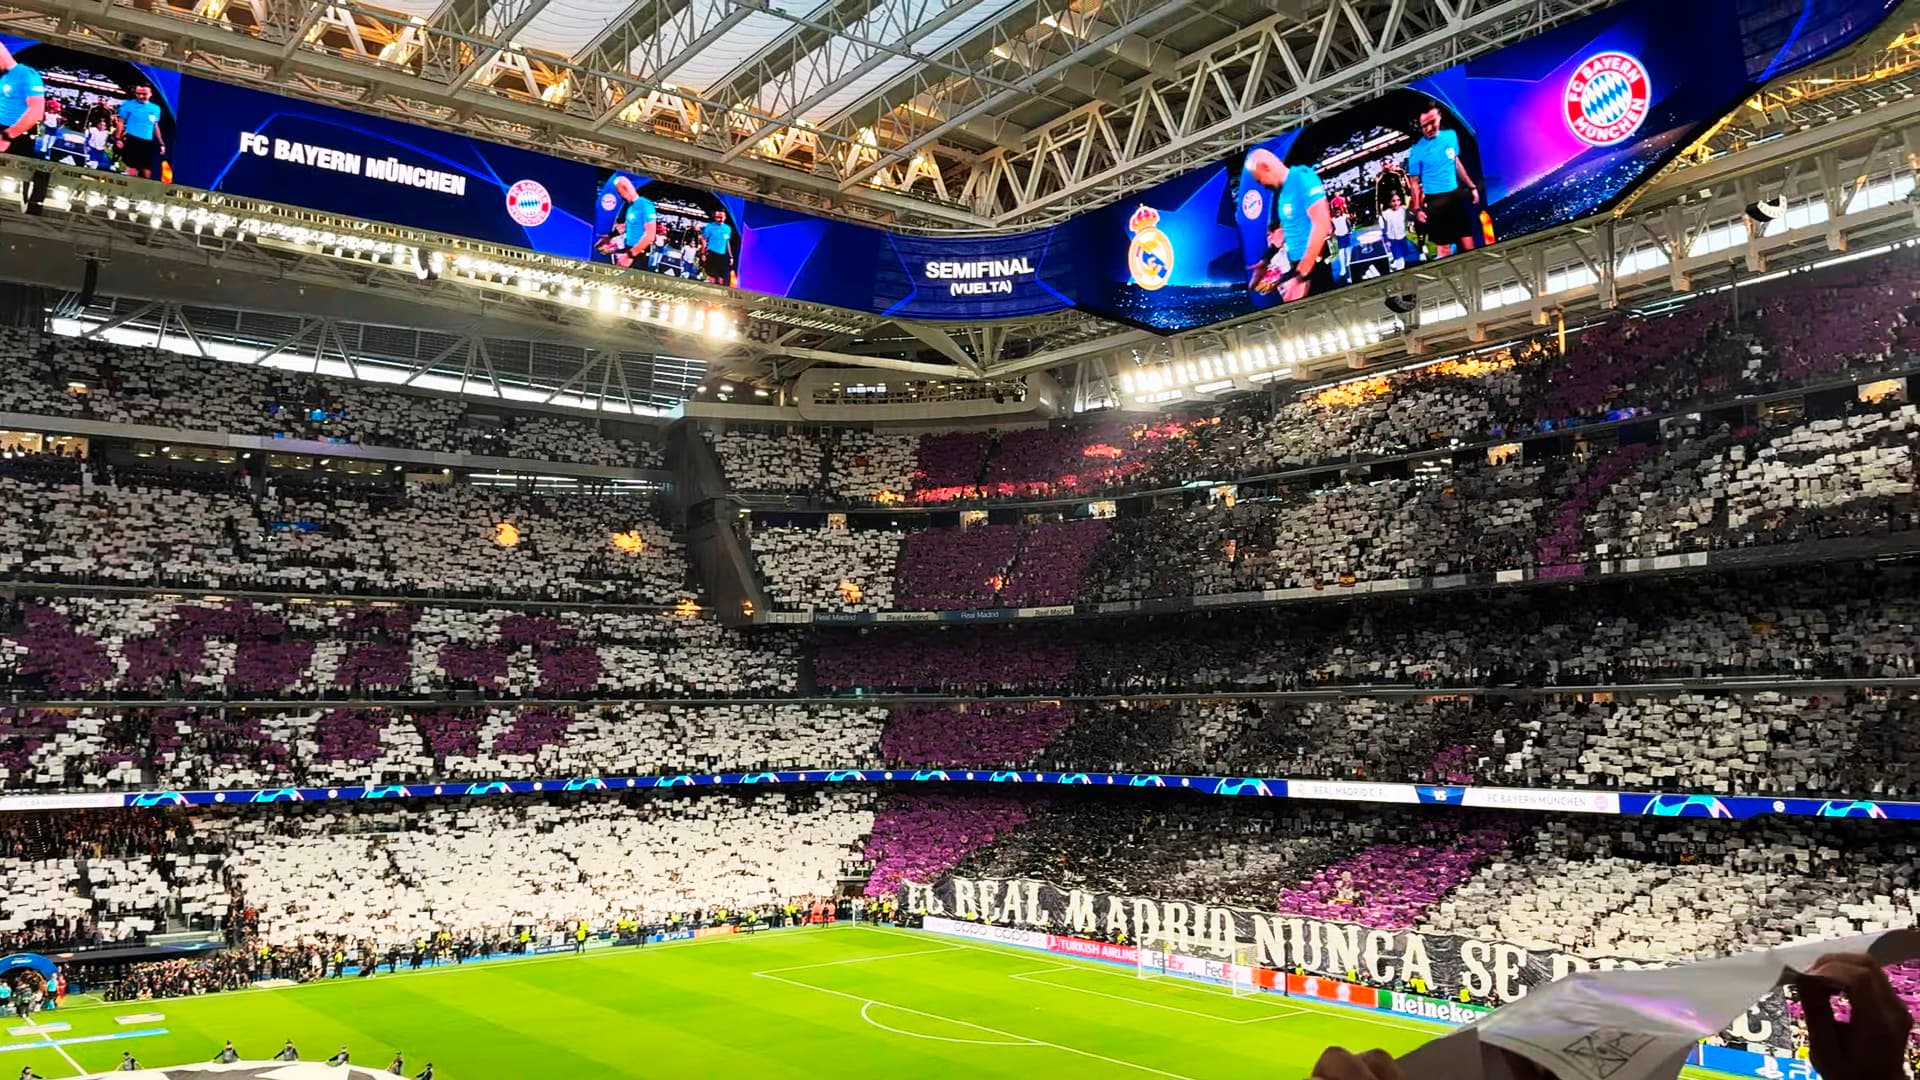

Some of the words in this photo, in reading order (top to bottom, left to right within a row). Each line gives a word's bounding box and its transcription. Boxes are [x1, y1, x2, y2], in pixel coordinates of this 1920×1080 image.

[1569, 82, 1584, 102] FC
[1581, 57, 1641, 83] BAYERN
[239, 132, 270, 156] FC
[274, 138, 361, 175] BAYERN
[365, 156, 467, 196] MÜNCHEN
[925, 257, 1035, 279] SEMIFINAL
[950, 280, 1012, 296] (VUELTA)
[833, 612, 857, 621] Madrid
[977, 610, 1000, 618] Madrid
[1335, 786, 1368, 797] MADRID
[1433, 790, 1447, 801] VS
[953, 921, 987, 936] oppo
[994, 928, 1029, 942] oppo
[907, 882, 945, 915] EL
[953, 878, 1050, 925] REAL
[1064, 889, 1236, 957] MADRID
[1251, 914, 1438, 990] NUNCA
[1460, 939, 1528, 1003] SE
[1060, 939, 1100, 955] TURKISH
[1101, 945, 1139, 962] AIRLINE
